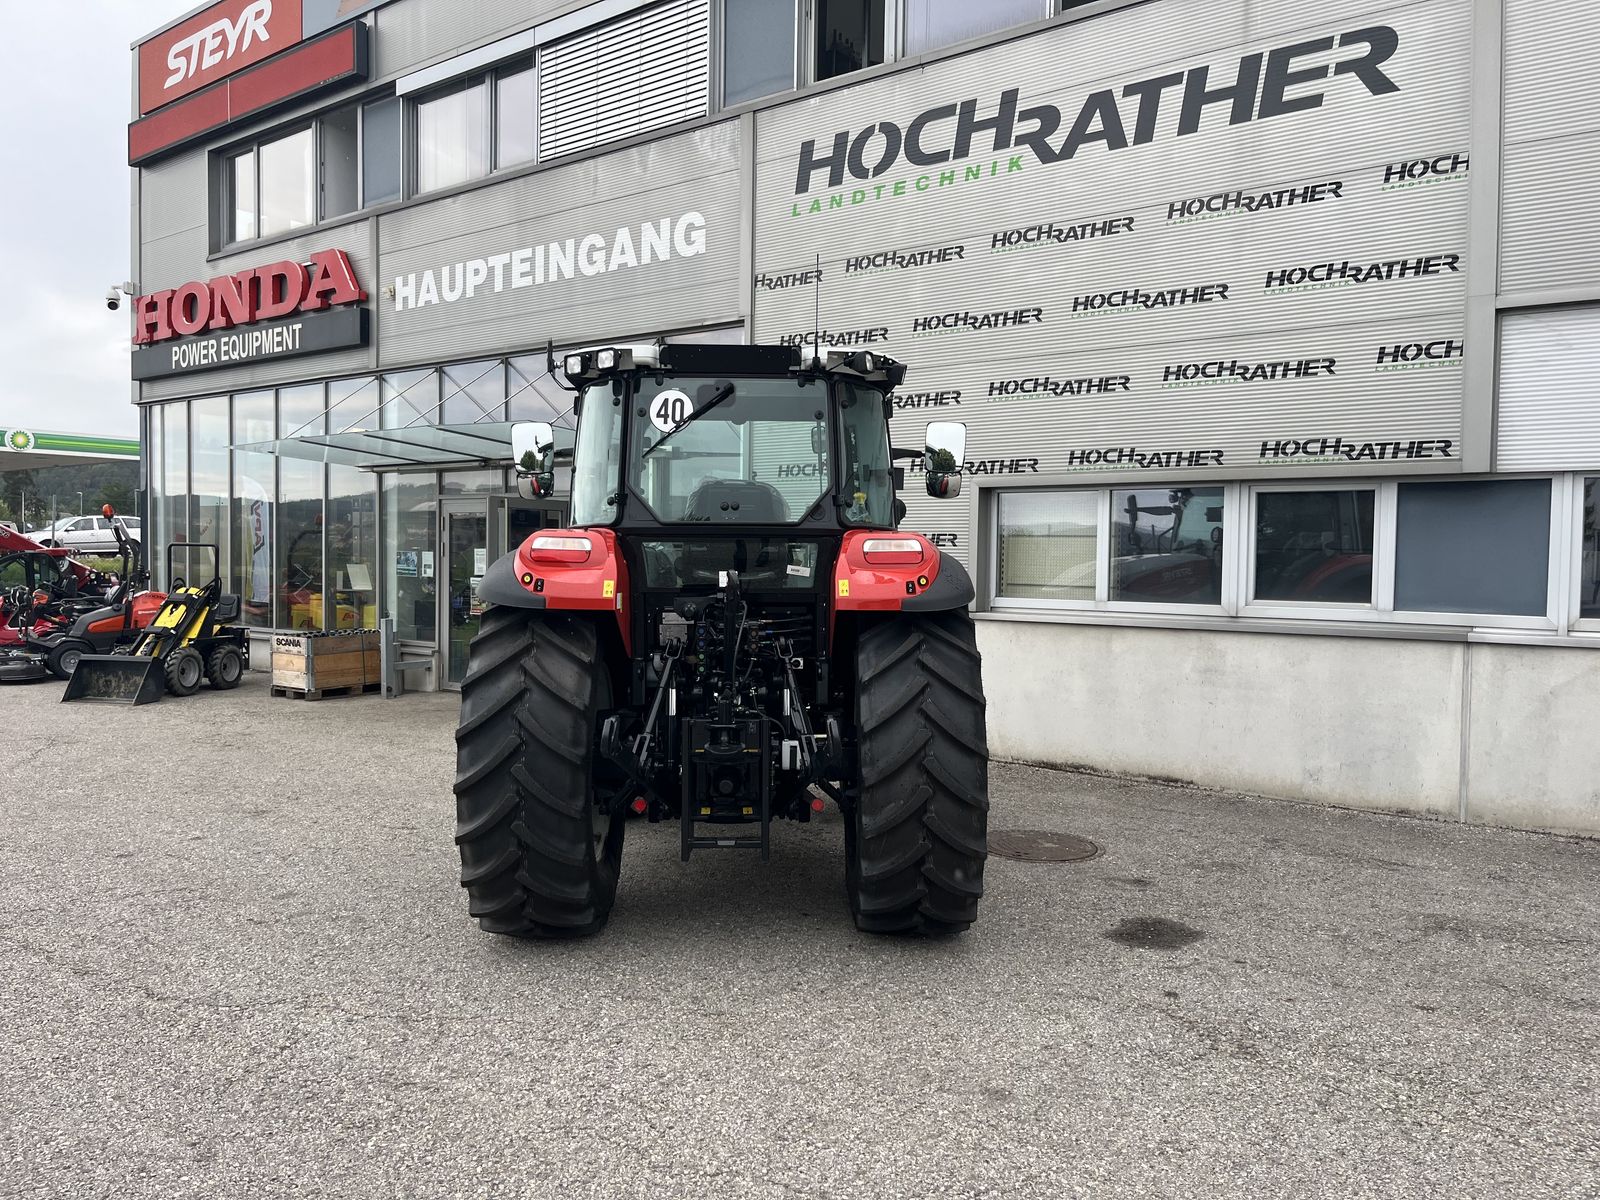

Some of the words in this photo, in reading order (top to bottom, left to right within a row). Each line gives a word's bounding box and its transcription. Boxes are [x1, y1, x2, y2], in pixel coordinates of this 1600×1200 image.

[163, 0, 272, 90] STEYR
[795, 25, 1401, 195] HOCHRATHER
[791, 155, 1024, 217] LANDTECHNIK
[1167, 181, 1343, 220] HOCHRATHER
[991, 216, 1135, 249] HOCHRATHER
[395, 211, 707, 312] HAUPTEINGANG
[845, 245, 965, 273] HOCHRATHER
[1264, 254, 1460, 288] HOCHRATHER
[133, 248, 361, 345] HONDA
[1072, 283, 1229, 312] HOCHRATHER
[912, 307, 1043, 333] HOCHRATHER
[172, 338, 218, 369] POWER
[221, 324, 302, 361] EQUIPMENT
[780, 327, 889, 347] HOCHRATHER
[1163, 357, 1337, 382] HOCHRATHER
[988, 375, 1131, 397] HOCHRATHER
[656, 397, 685, 425] 40
[1068, 447, 1225, 469] HOCHRATHER
[1259, 437, 1453, 461] HOCHRATHER
[276, 637, 302, 648] SCANIA
